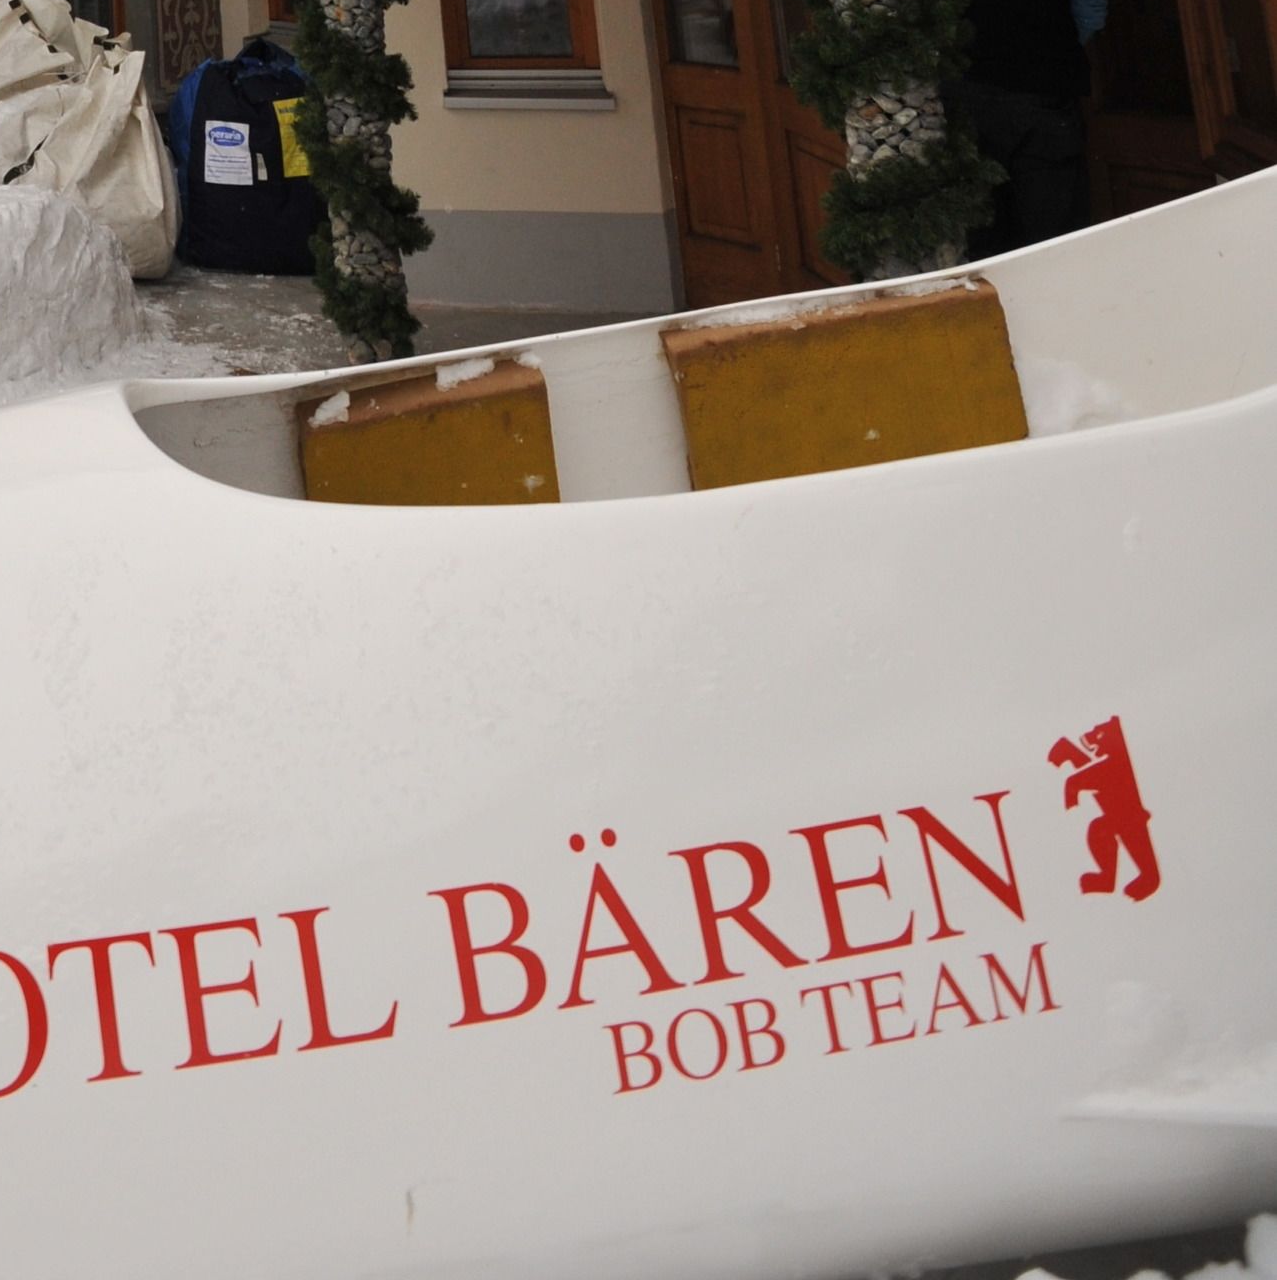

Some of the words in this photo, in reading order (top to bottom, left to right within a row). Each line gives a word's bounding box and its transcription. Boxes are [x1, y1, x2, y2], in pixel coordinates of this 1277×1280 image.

[428, 789, 1028, 1030] BÄREN
[602, 997, 787, 1095] BOB
[799, 941, 1062, 1057] TEAM
